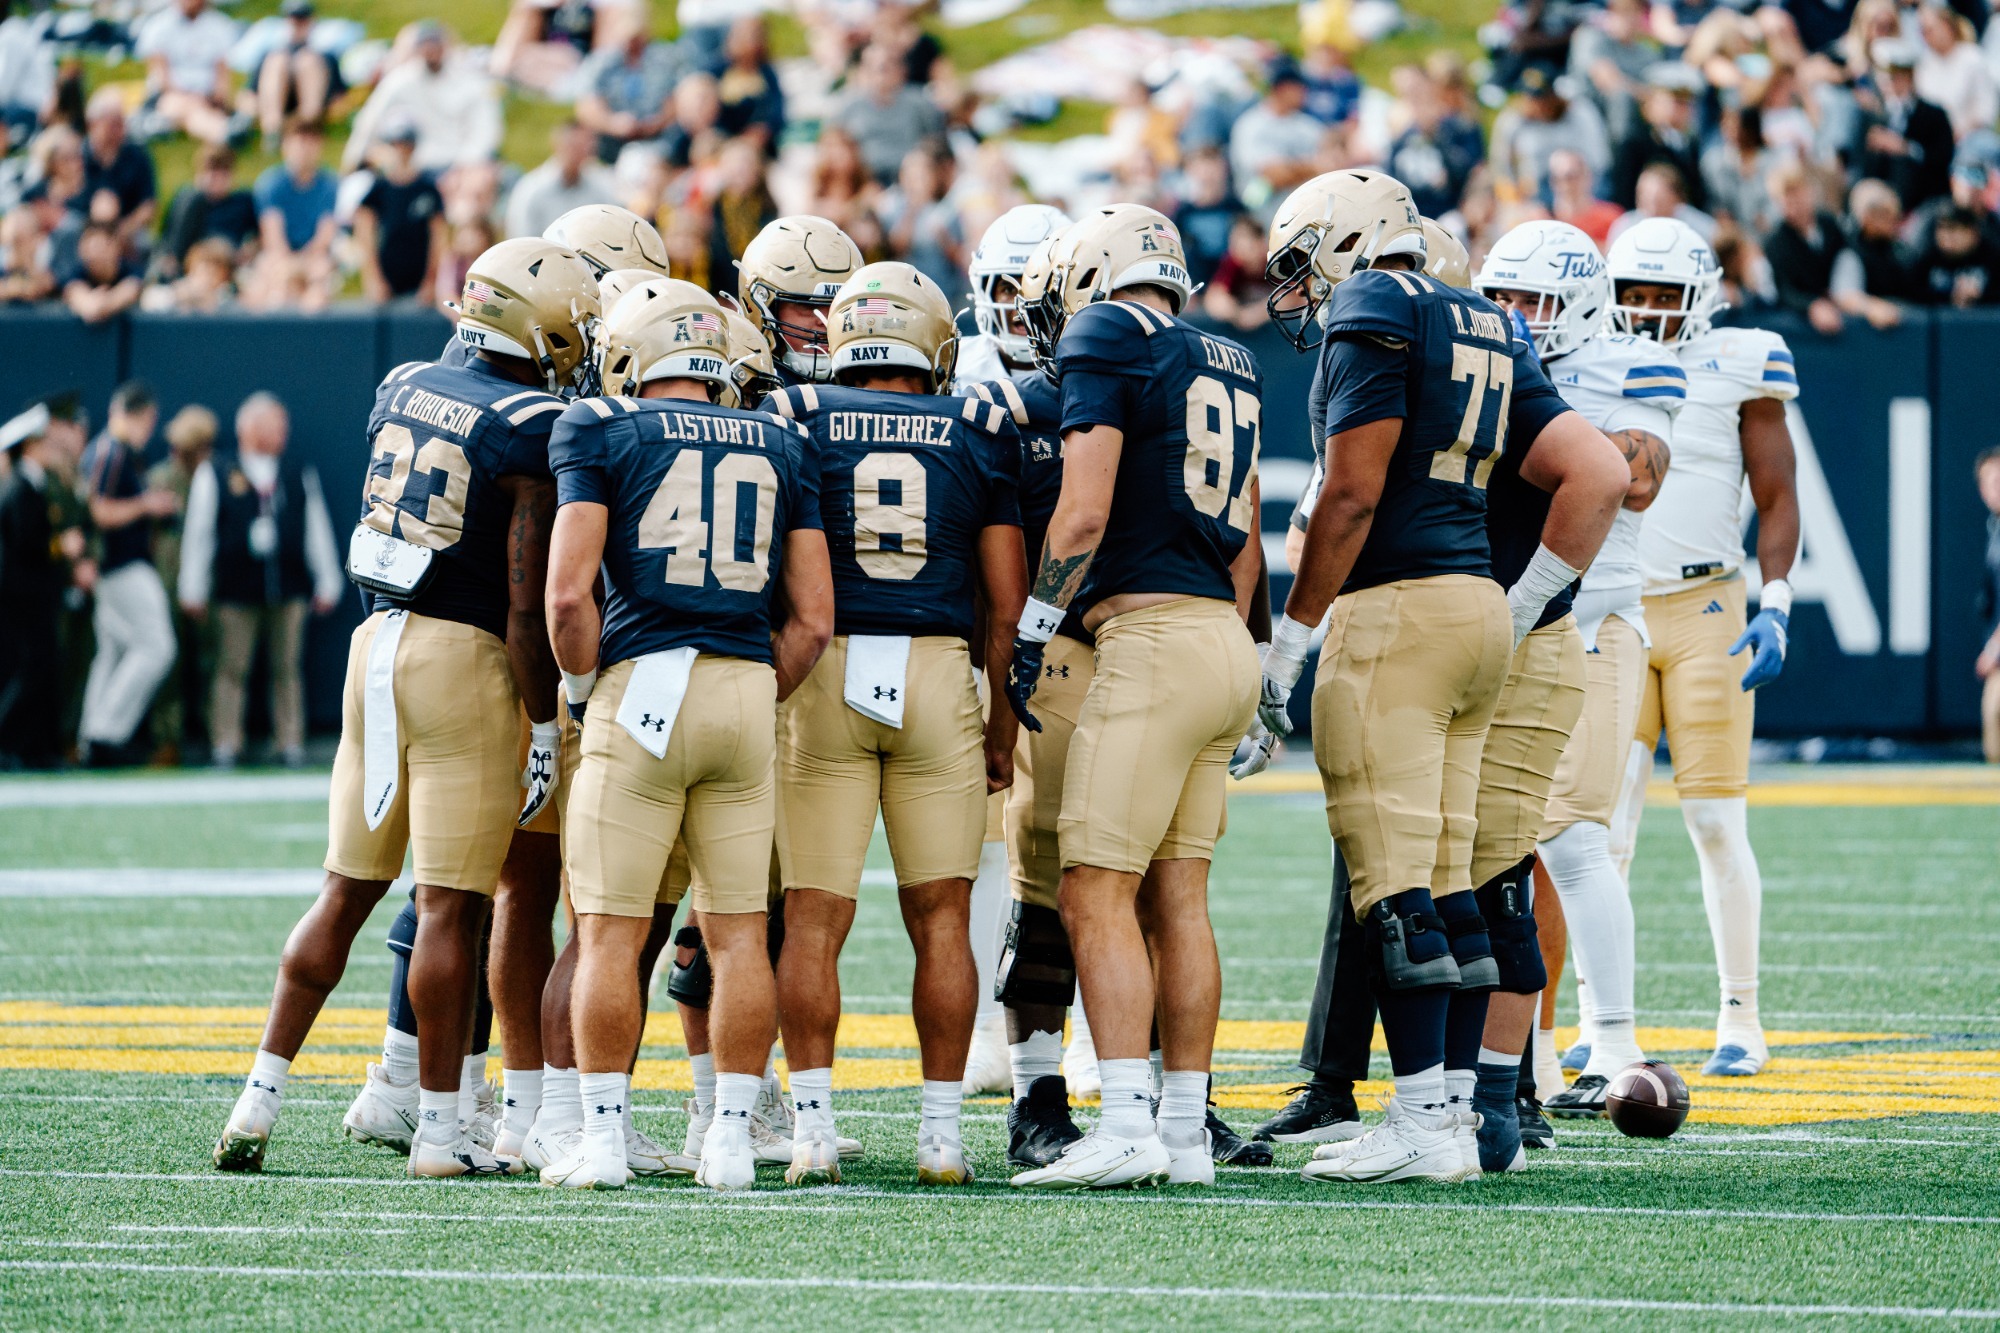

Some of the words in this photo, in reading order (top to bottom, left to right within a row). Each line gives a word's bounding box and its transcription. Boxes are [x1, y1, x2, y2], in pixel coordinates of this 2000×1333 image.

[823, 284, 842, 296] NAV
[1159, 263, 1187, 284] NAVY
[460, 328, 486, 346] NAVY
[851, 347, 889, 361] NAVY
[689, 358, 722, 375] NAVY
[1200, 336, 1255, 382] ELWELL
[390, 385, 410, 413] C.
[402, 389, 483, 438] ROBINSON
[829, 412, 953, 446] GUTIERREZ
[1429, 342, 1513, 489] 77
[659, 412, 765, 448] LISTORTI
[1033, 452, 1053, 462] USAA
[1184, 375, 1261, 534] 87
[361, 422, 471, 551] 23
[638, 449, 777, 593] 40
[854, 453, 927, 580] 8
